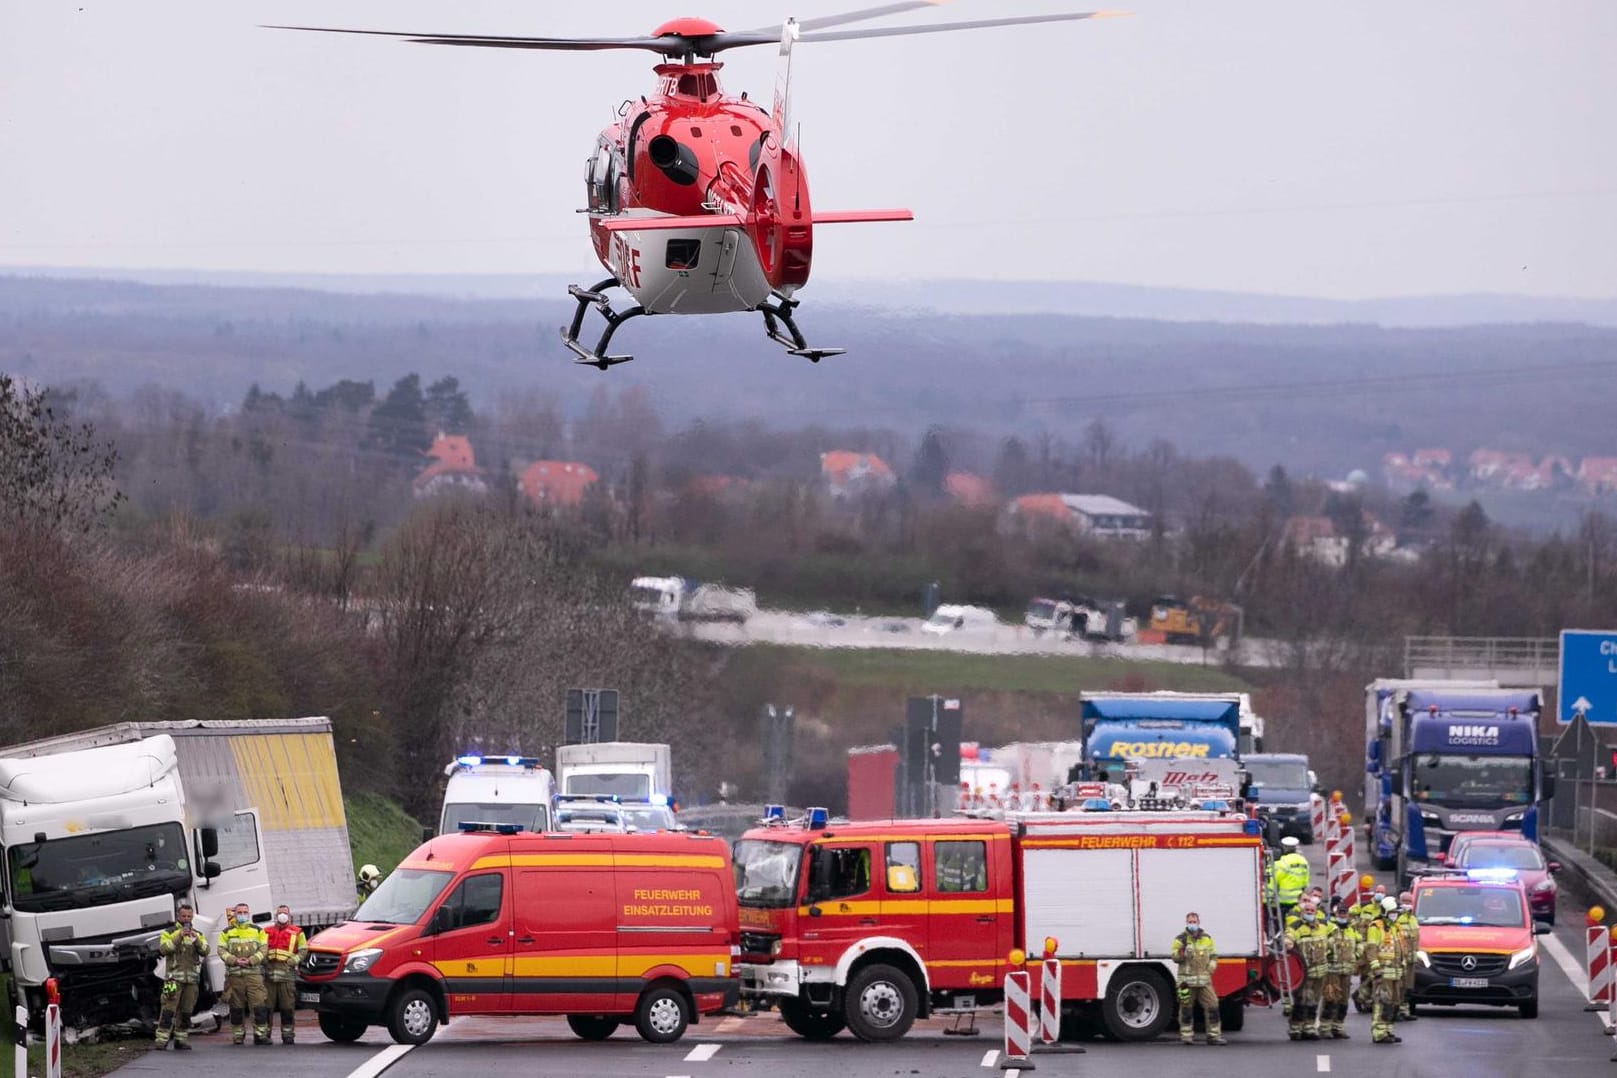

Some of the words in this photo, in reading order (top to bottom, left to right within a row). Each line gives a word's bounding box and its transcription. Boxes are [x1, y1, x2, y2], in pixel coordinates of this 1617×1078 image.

[1448, 725, 1499, 738] NIKA
[1448, 737, 1499, 746] LOGISTICS
[1449, 814, 1496, 824] SCANIA
[1080, 836, 1157, 849] FEUERWEHR
[1178, 836, 1195, 848] 112
[633, 889, 701, 901] FEUERWEHR
[623, 905, 713, 917] EINSATZLEITUNG
[89, 950, 118, 959] DA
